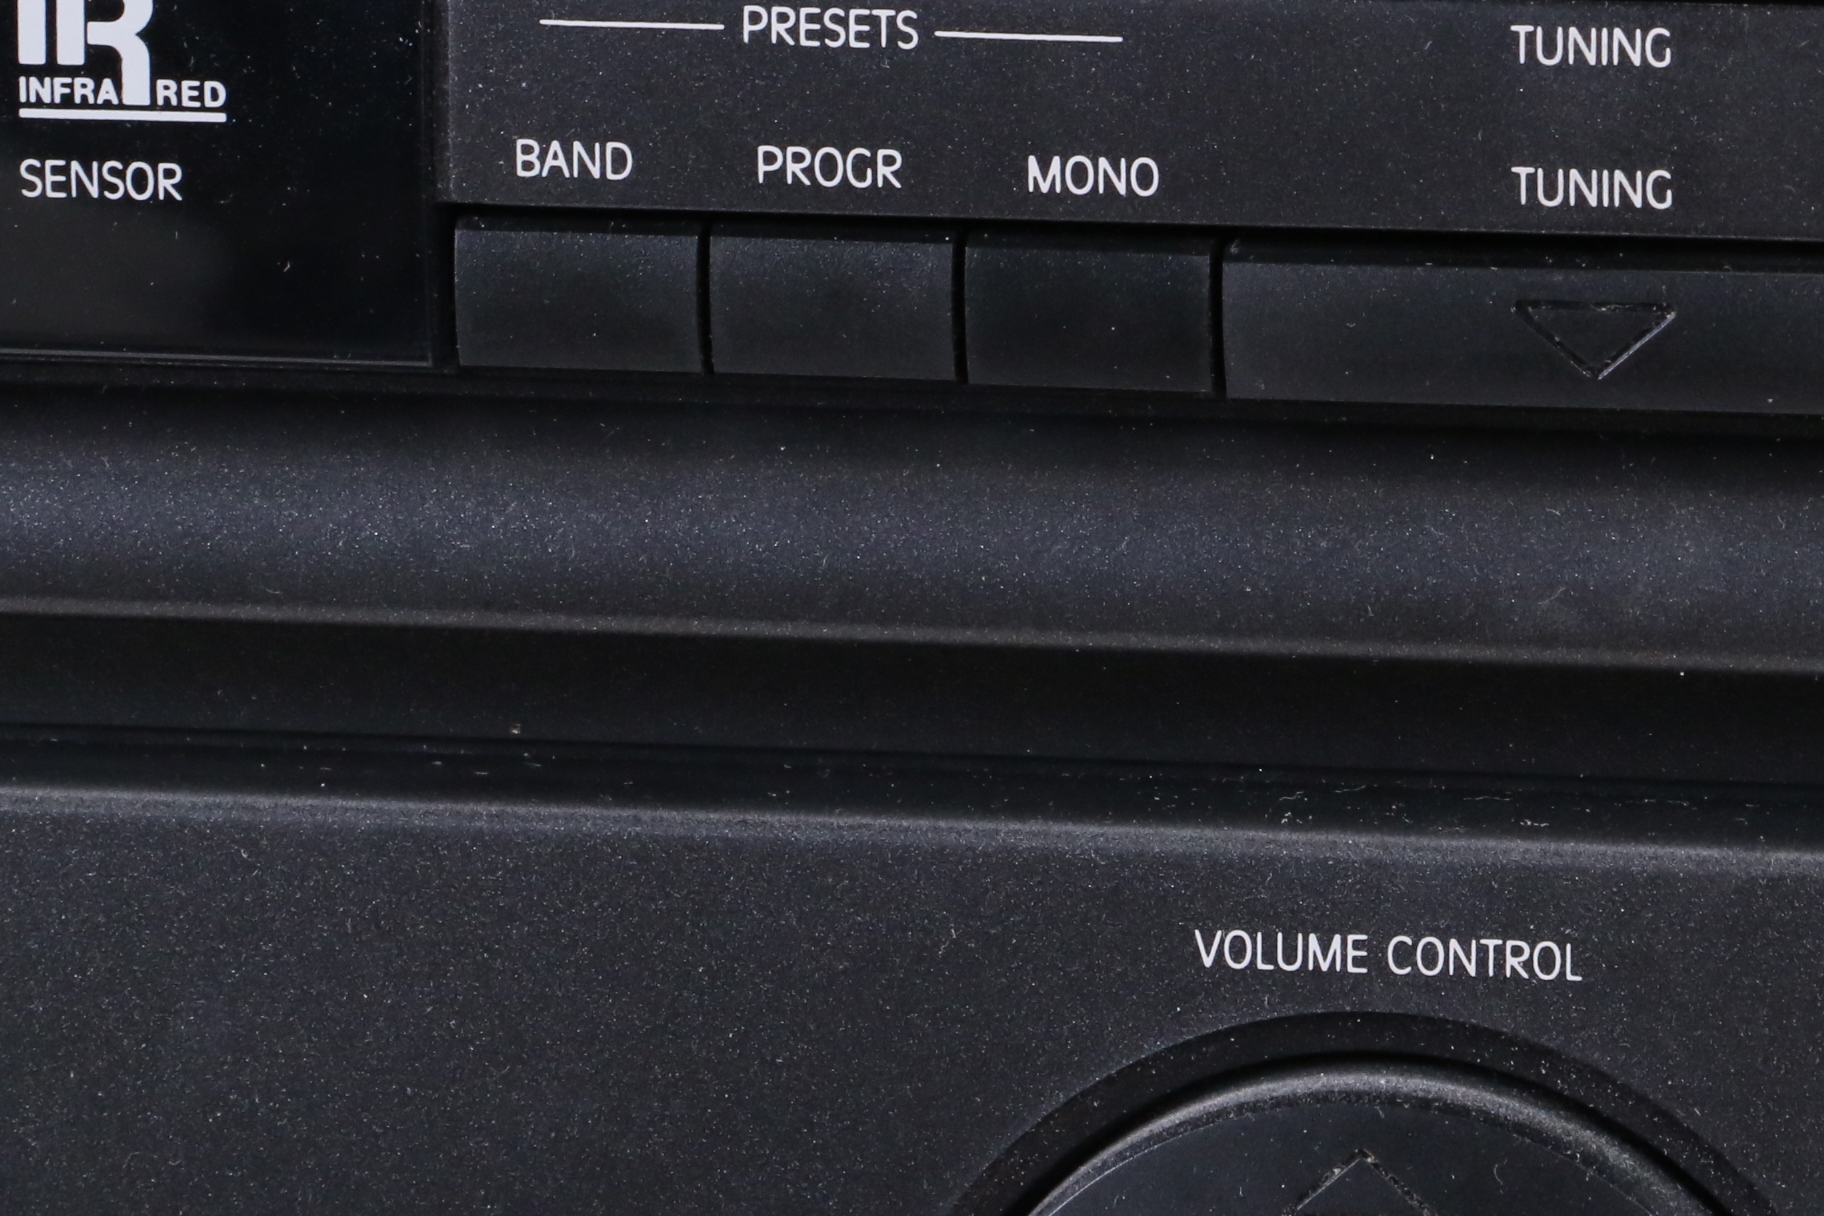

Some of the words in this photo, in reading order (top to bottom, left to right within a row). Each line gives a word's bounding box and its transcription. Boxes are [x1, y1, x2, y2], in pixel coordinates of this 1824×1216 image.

[742, 4, 919, 50] PRESETS
[1509, 24, 1673, 68] TUNING
[19, 158, 183, 201] SENSOR
[515, 138, 633, 181] BAND
[757, 144, 903, 189] PROGR
[1027, 154, 1160, 197] MONO
[1510, 166, 1674, 210] TUNING
[1194, 929, 1369, 974] VOLUME
[1387, 935, 1583, 982] CONTROL
